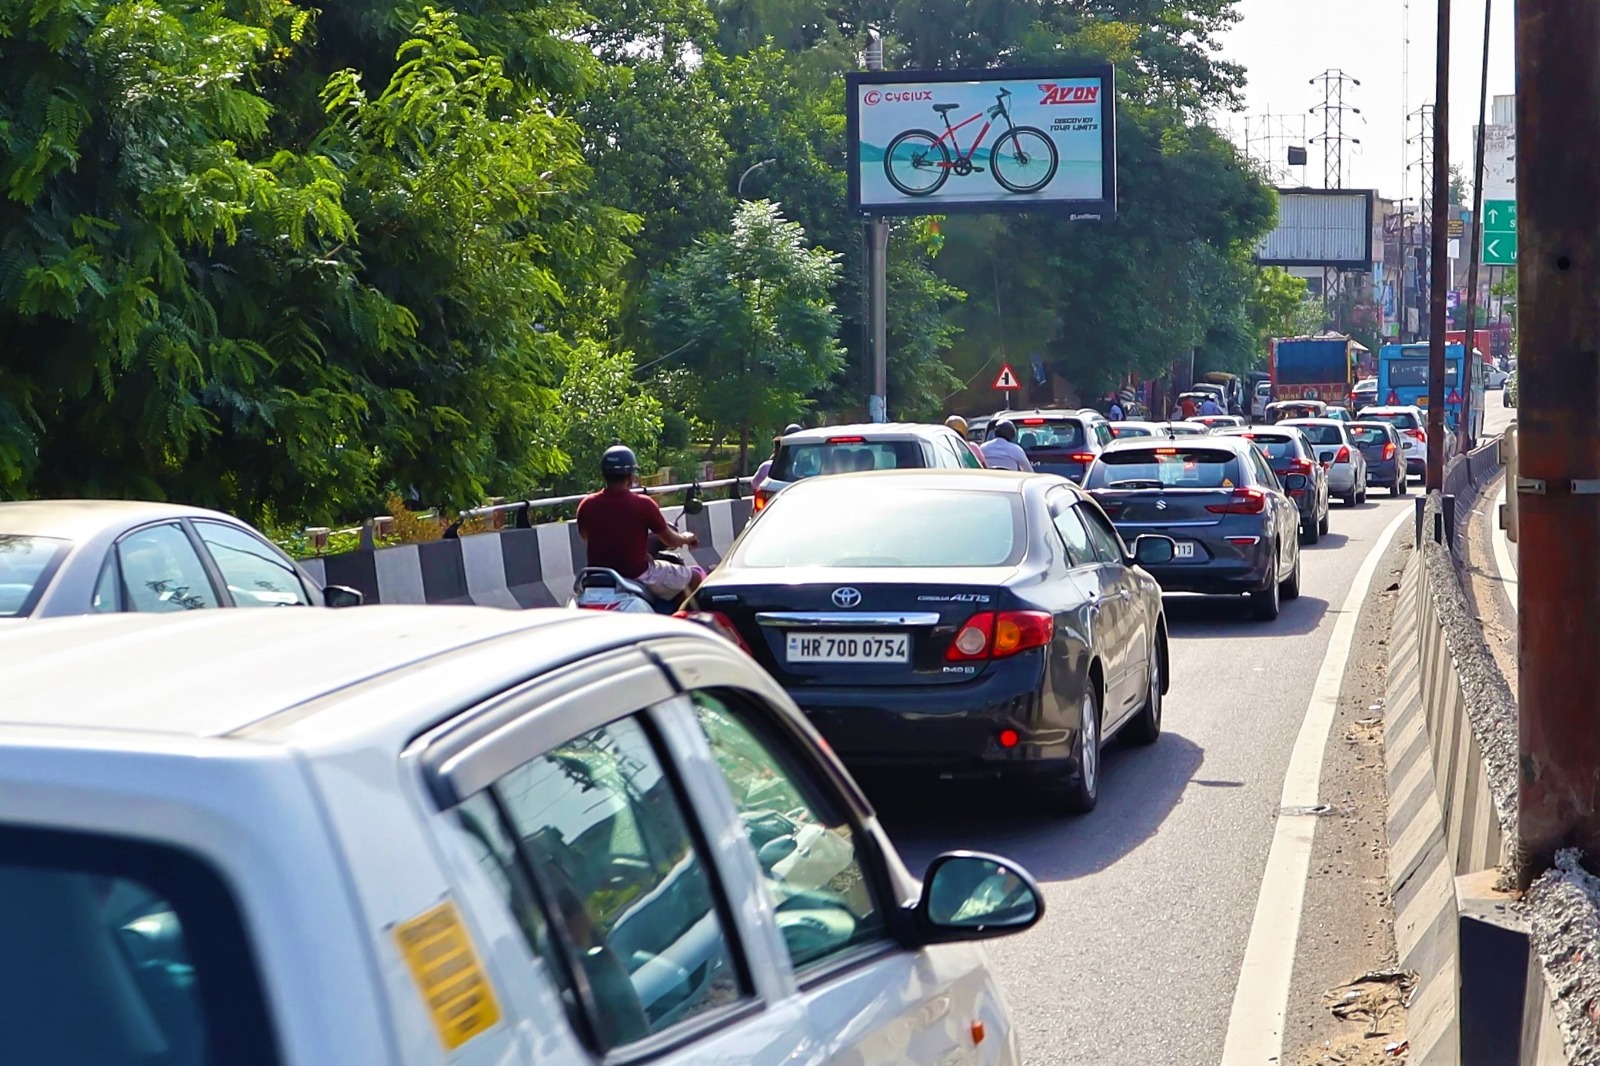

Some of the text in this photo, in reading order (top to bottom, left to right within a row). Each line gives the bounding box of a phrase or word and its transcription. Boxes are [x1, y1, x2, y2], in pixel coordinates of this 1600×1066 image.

[1037, 83, 1099, 104] AVON
[950, 593, 990, 603] ALTIS
[801, 638, 821, 657] HR
[826, 639, 858, 657] 70D
[862, 639, 906, 658] 0754
